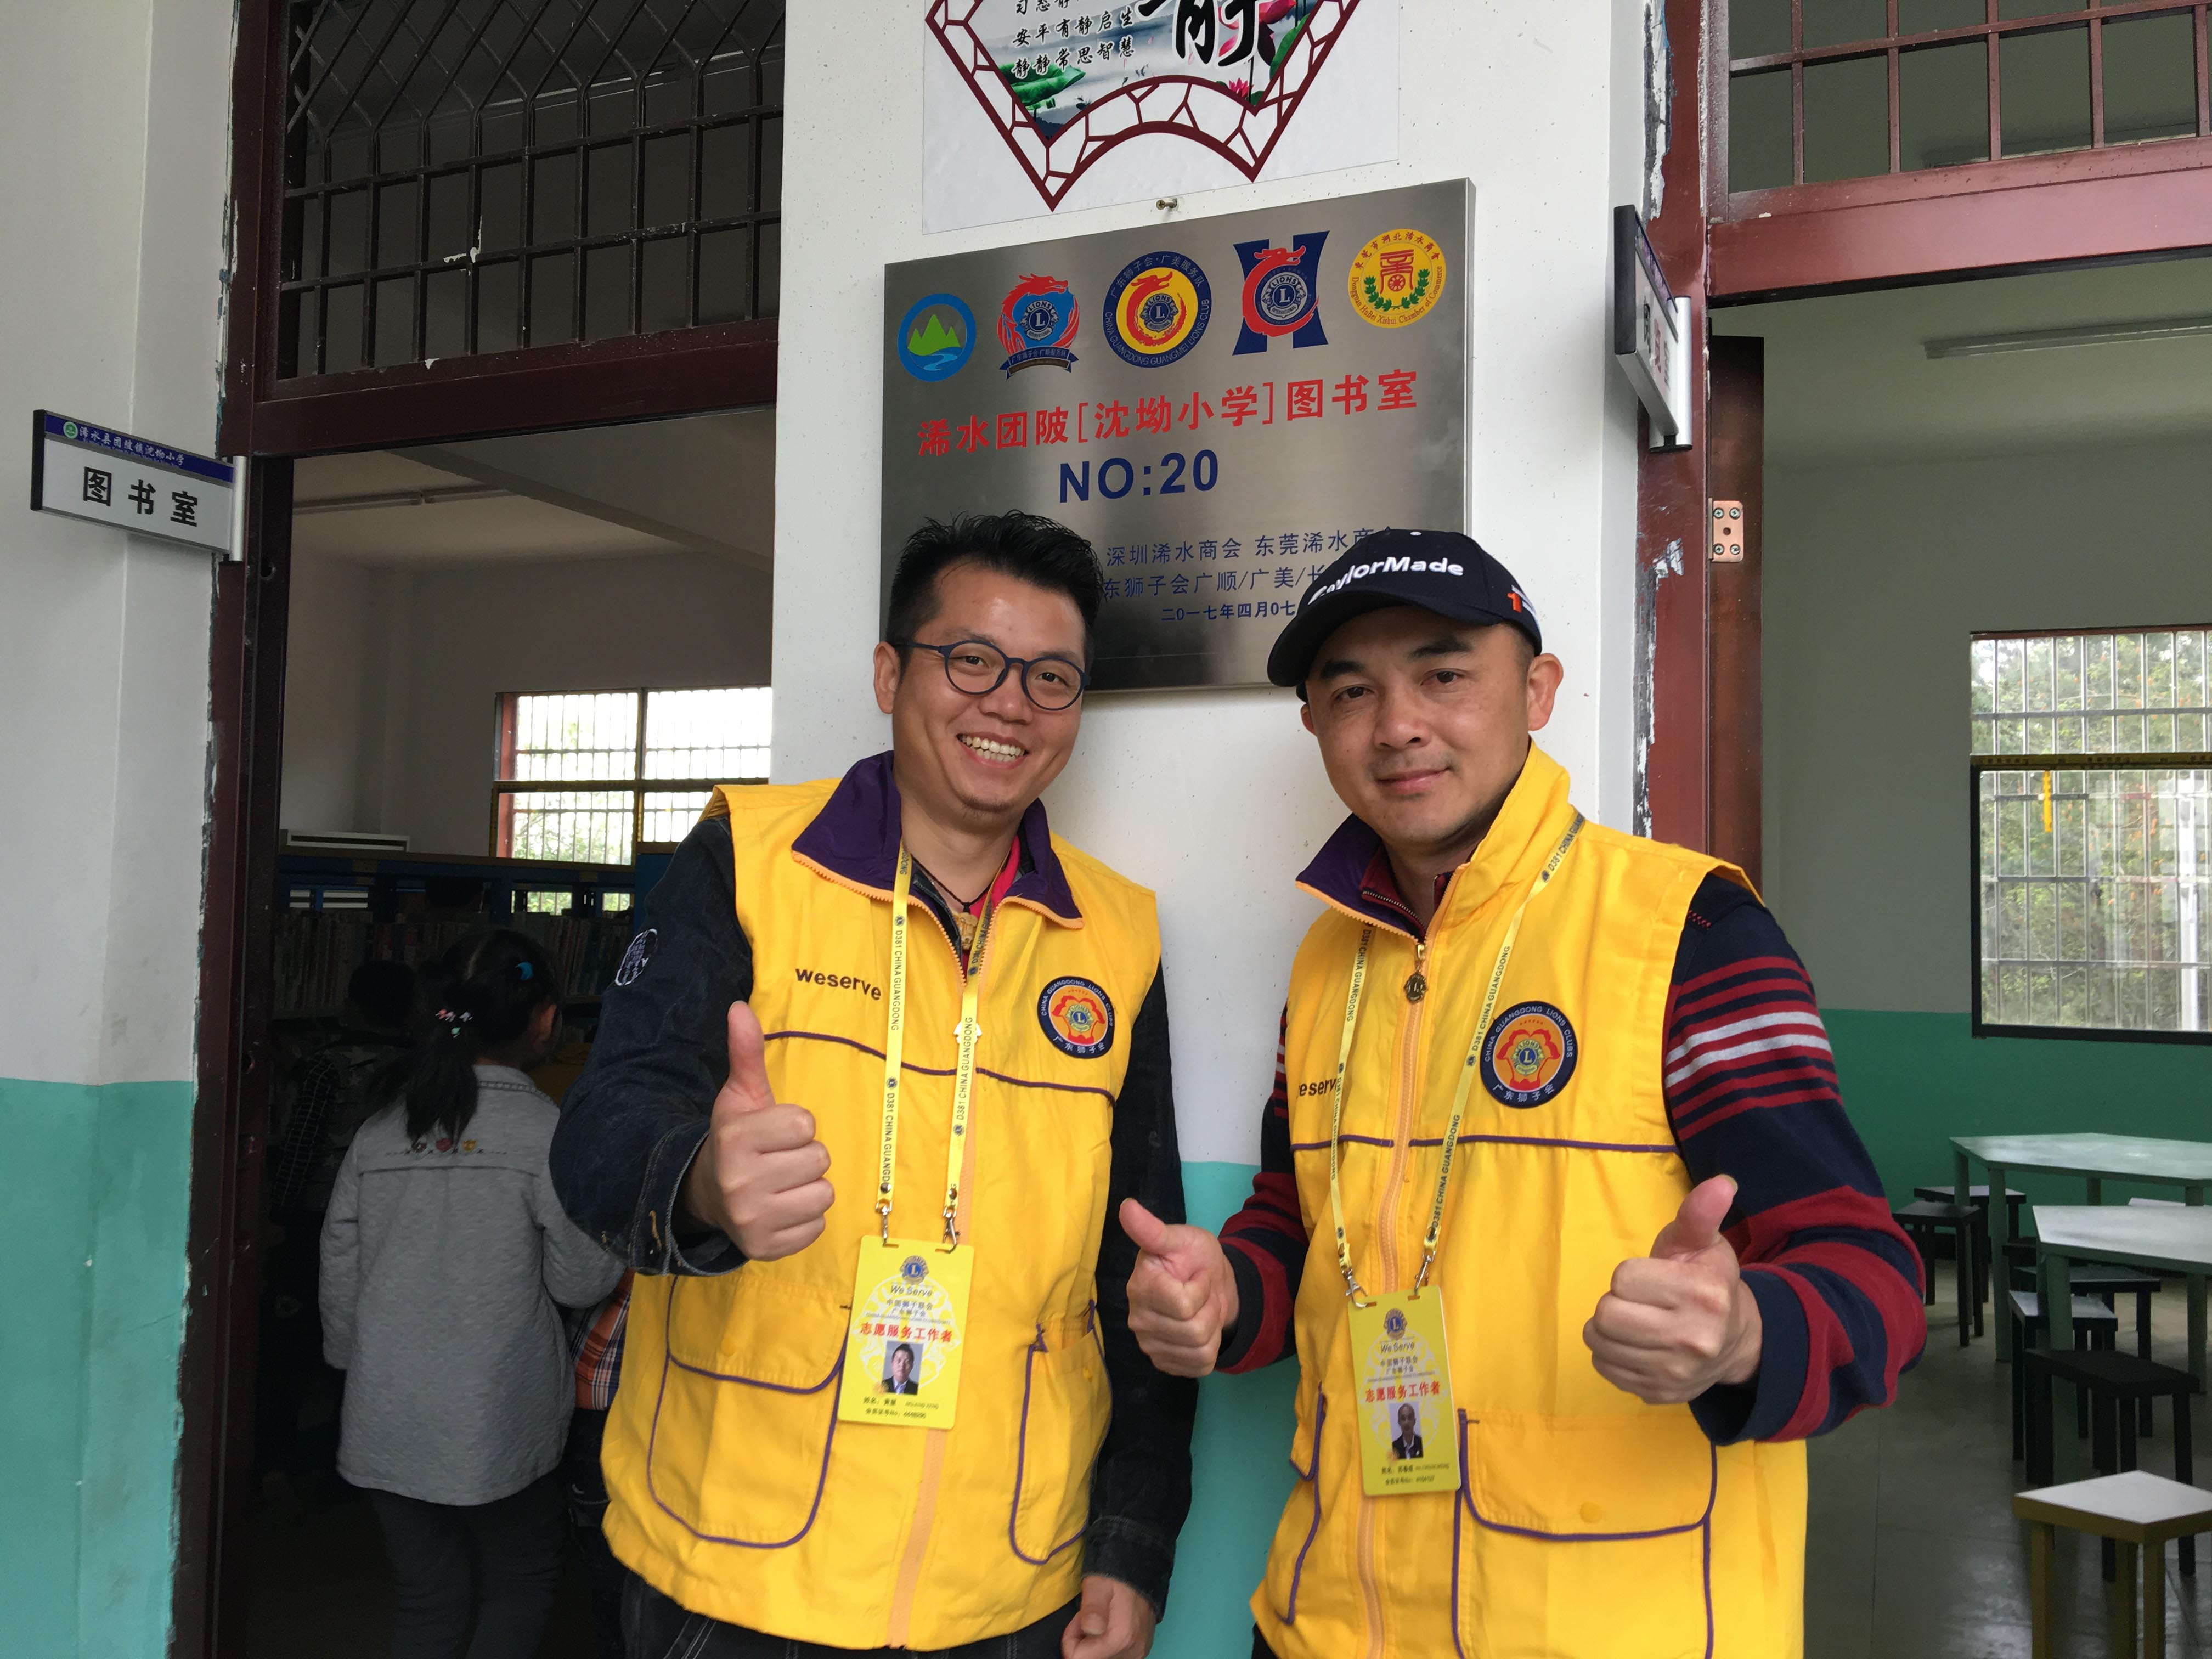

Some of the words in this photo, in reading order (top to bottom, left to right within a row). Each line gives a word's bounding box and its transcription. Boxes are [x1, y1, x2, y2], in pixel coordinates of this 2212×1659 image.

[1272, 275, 1298, 286] LIONS
[1149, 295, 1171, 304] LIONS
[1279, 288, 1291, 303] L
[1399, 306, 1425, 324] Chamber
[1429, 266, 1442, 299] Commerce
[1029, 301, 1051, 312] LIONS
[1155, 306, 1165, 319] L
[1035, 312, 1046, 327] L
[1105, 311, 1113, 336] CHINA
[1110, 334, 1149, 365] GUANGDONG
[1150, 342, 1189, 365] GUANGMEI
[1188, 321, 1205, 345] LIONS
[1199, 298, 1210, 320] CLUB
[82, 466, 199, 527] 图书室
[1106, 536, 1243, 567] 深圳浠水商会
[1548, 851, 1563, 872] D381
[1558, 833, 1575, 854] CHINA
[894, 929, 903, 949] D381
[1358, 929, 1372, 947] D381
[894, 950, 902, 977] CHINA
[1355, 946, 1367, 971] CHINA
[795, 968, 882, 1001] weserve
[1047, 979, 1085, 995] GUANGDONG
[1088, 984, 1106, 1001] LIONS
[890, 977, 902, 1031] GUANGDONG
[1347, 972, 1362, 1022] GUANGDONG
[1472, 1030, 1484, 1052] D381
[1480, 1002, 1493, 1030] CHINA
[1489, 945, 1511, 1002] GUANGDONG
[1077, 1013, 1085, 1024] L
[961, 1017, 973, 1071] GUANGDONG
[1485, 1036, 1496, 1062] CHINA
[1495, 1005, 1543, 1034] GUANGDONG
[1545, 1008, 1566, 1026] LIONS
[1564, 1029, 1573, 1058] CLUBS
[1523, 1050, 1532, 1063] L
[958, 1072, 968, 1099] CHINA
[1299, 1077, 1338, 1097] eserv
[1493, 1084, 1556, 1102] 广东狮子会
[885, 1092, 895, 1113] D381
[956, 1101, 966, 1121] D381
[884, 1115, 894, 1143] CHINA
[1436, 1175, 1447, 1204] CHINA
[1442, 1114, 1460, 1173] GUANGDONG
[890, 1285, 904, 1295] We
[906, 1286, 933, 1297] Serve
[860, 1323, 953, 1343] 志愿服务工作者
[1381, 1344, 1392, 1353] We
[1393, 1342, 1414, 1352] Serve
[1365, 1380, 1440, 1403] 志愿服务工作者
